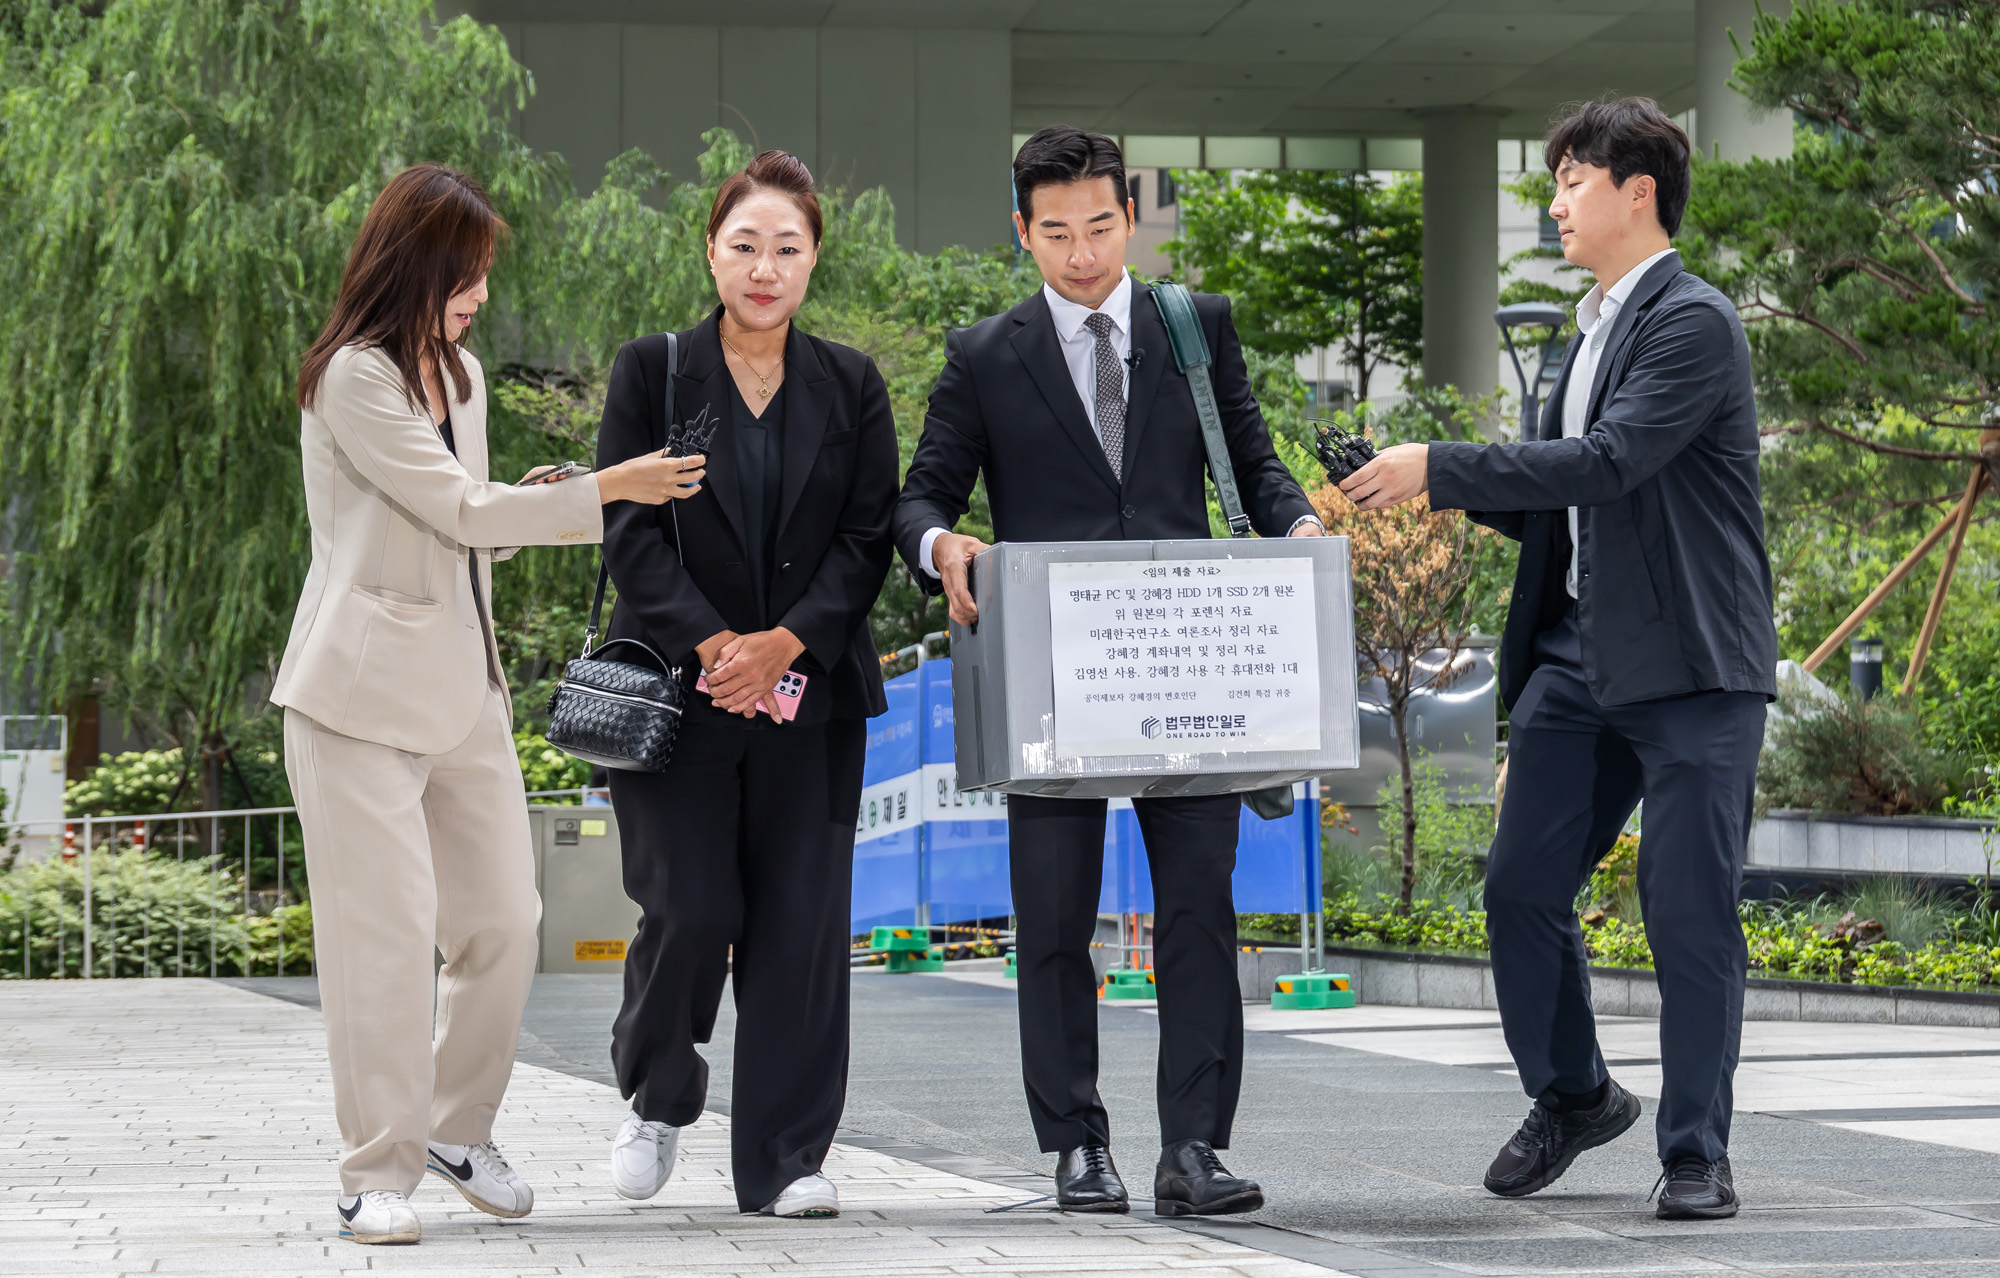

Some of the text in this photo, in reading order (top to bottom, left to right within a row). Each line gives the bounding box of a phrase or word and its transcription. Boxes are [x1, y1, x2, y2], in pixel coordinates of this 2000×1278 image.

[1172, 567, 1191, 577] 제출
[1070, 585, 1294, 602] 명태균 PC 및 강혜경 HDD 1개 SSD 2개 원본
[1115, 606, 1253, 620] 위 원본의 각 포렌식 자료
[1090, 624, 1279, 640] 미래한국연구소 여론조사 정리 자료
[1106, 644, 1266, 660] 강혜경 계좌내역 및 정리 자료
[1075, 667, 1107, 680] 김영선
[1147, 665, 1179, 678] 강혜경
[1186, 665, 1208, 677] 사용
[1215, 664, 1225, 676] 각
[1231, 663, 1275, 676] 휴대전화
[1283, 662, 1298, 674] 1대
[1166, 715, 1246, 730] 법무법인일로
[882, 790, 907, 823] 제일
